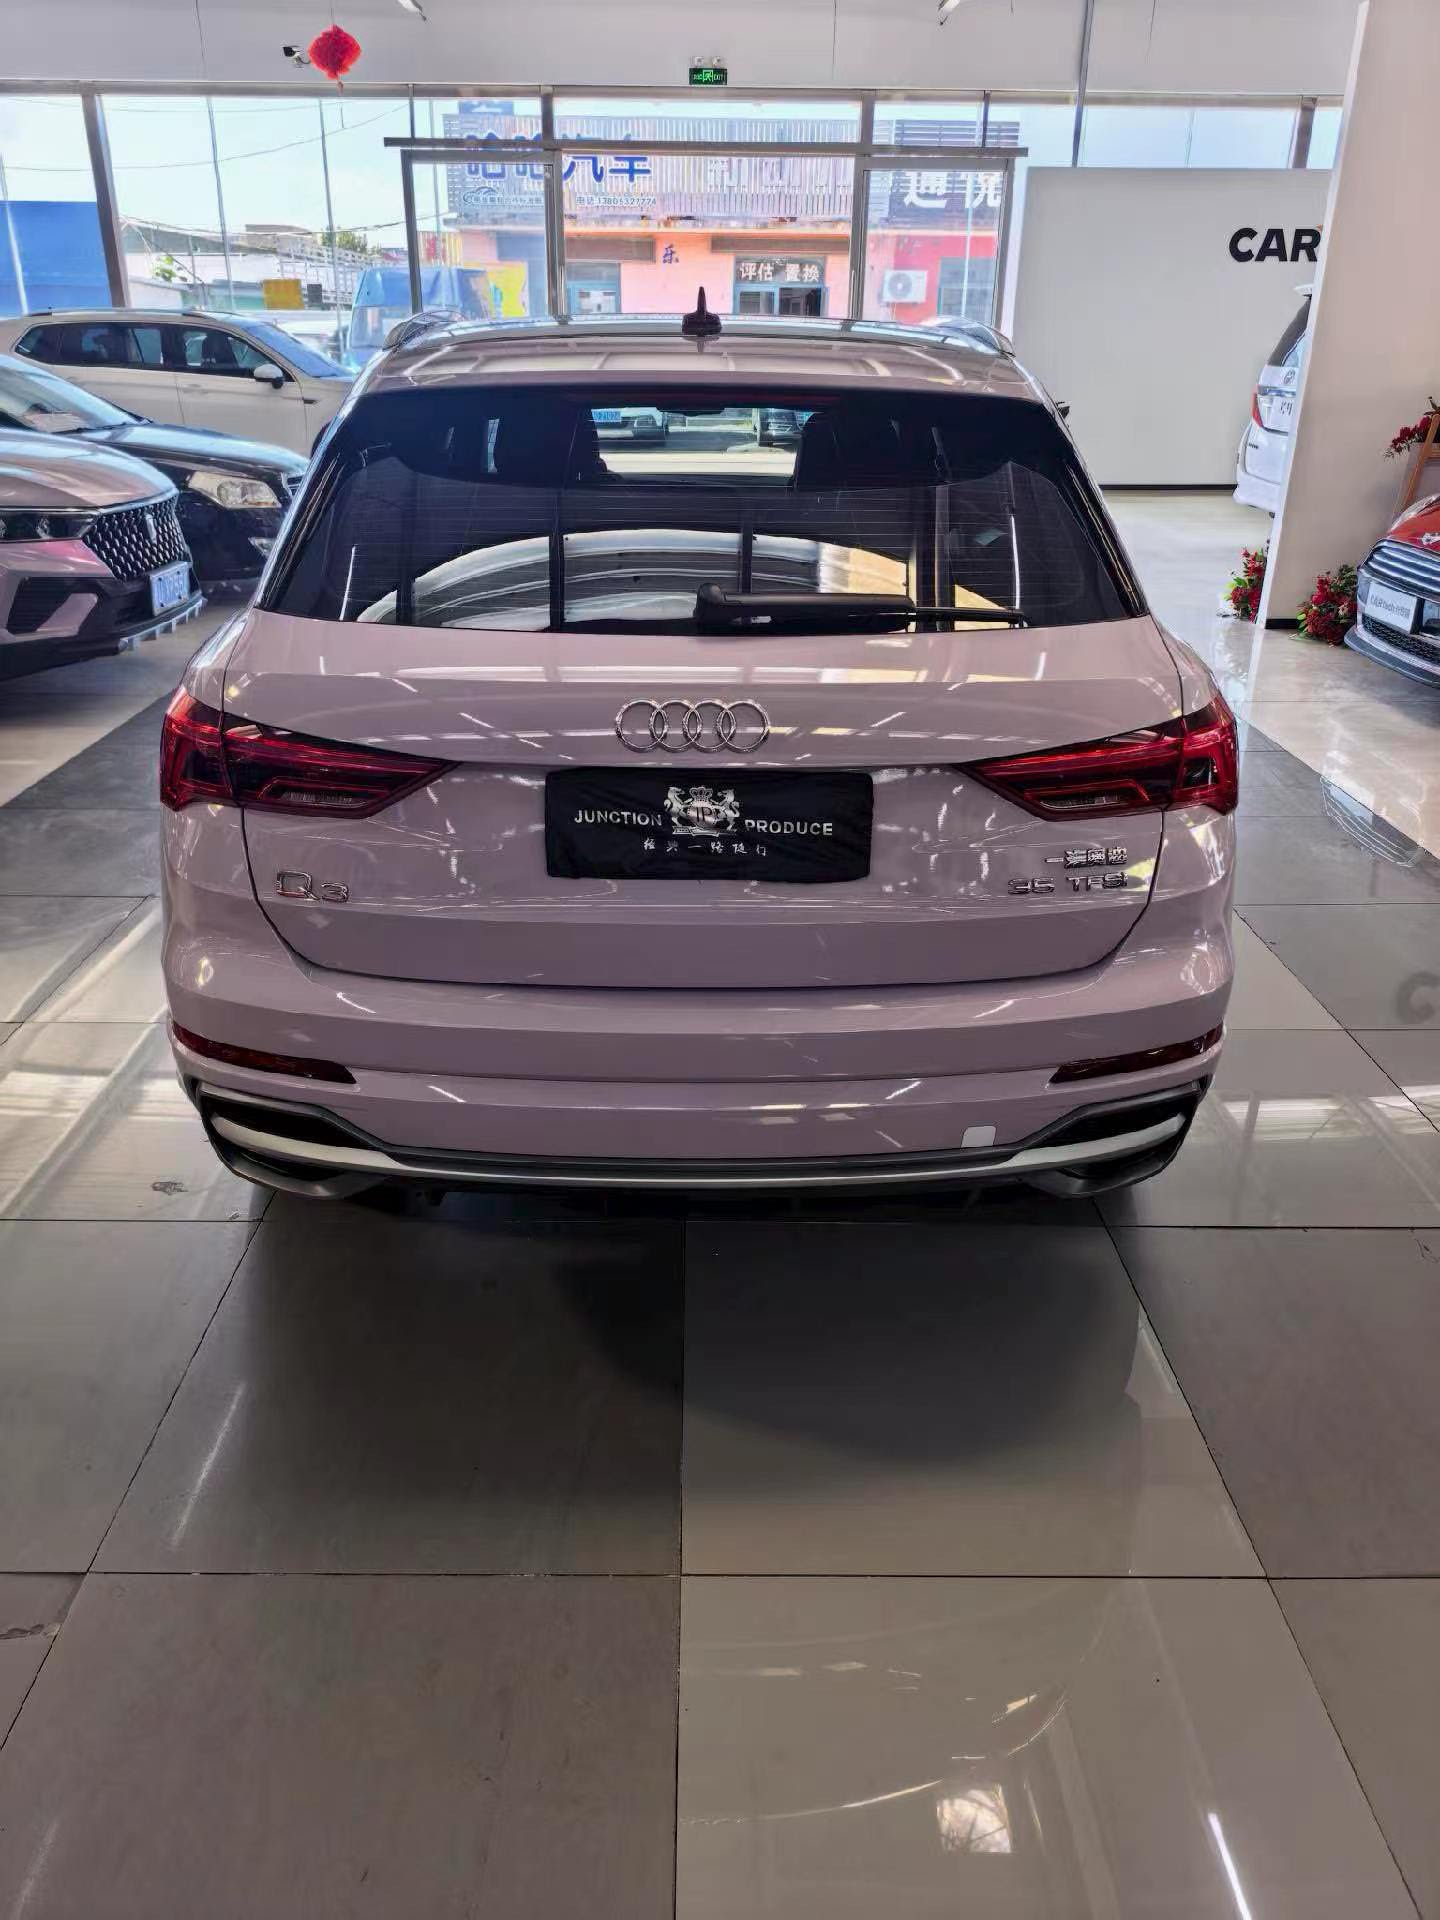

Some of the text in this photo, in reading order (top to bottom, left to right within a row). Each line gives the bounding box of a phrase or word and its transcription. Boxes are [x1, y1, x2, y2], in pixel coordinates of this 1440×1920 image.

[739, 262, 820, 282] 评估 置换
[574, 809, 833, 836] JUNCTION PRODUCE
[276, 870, 350, 903] Q3
